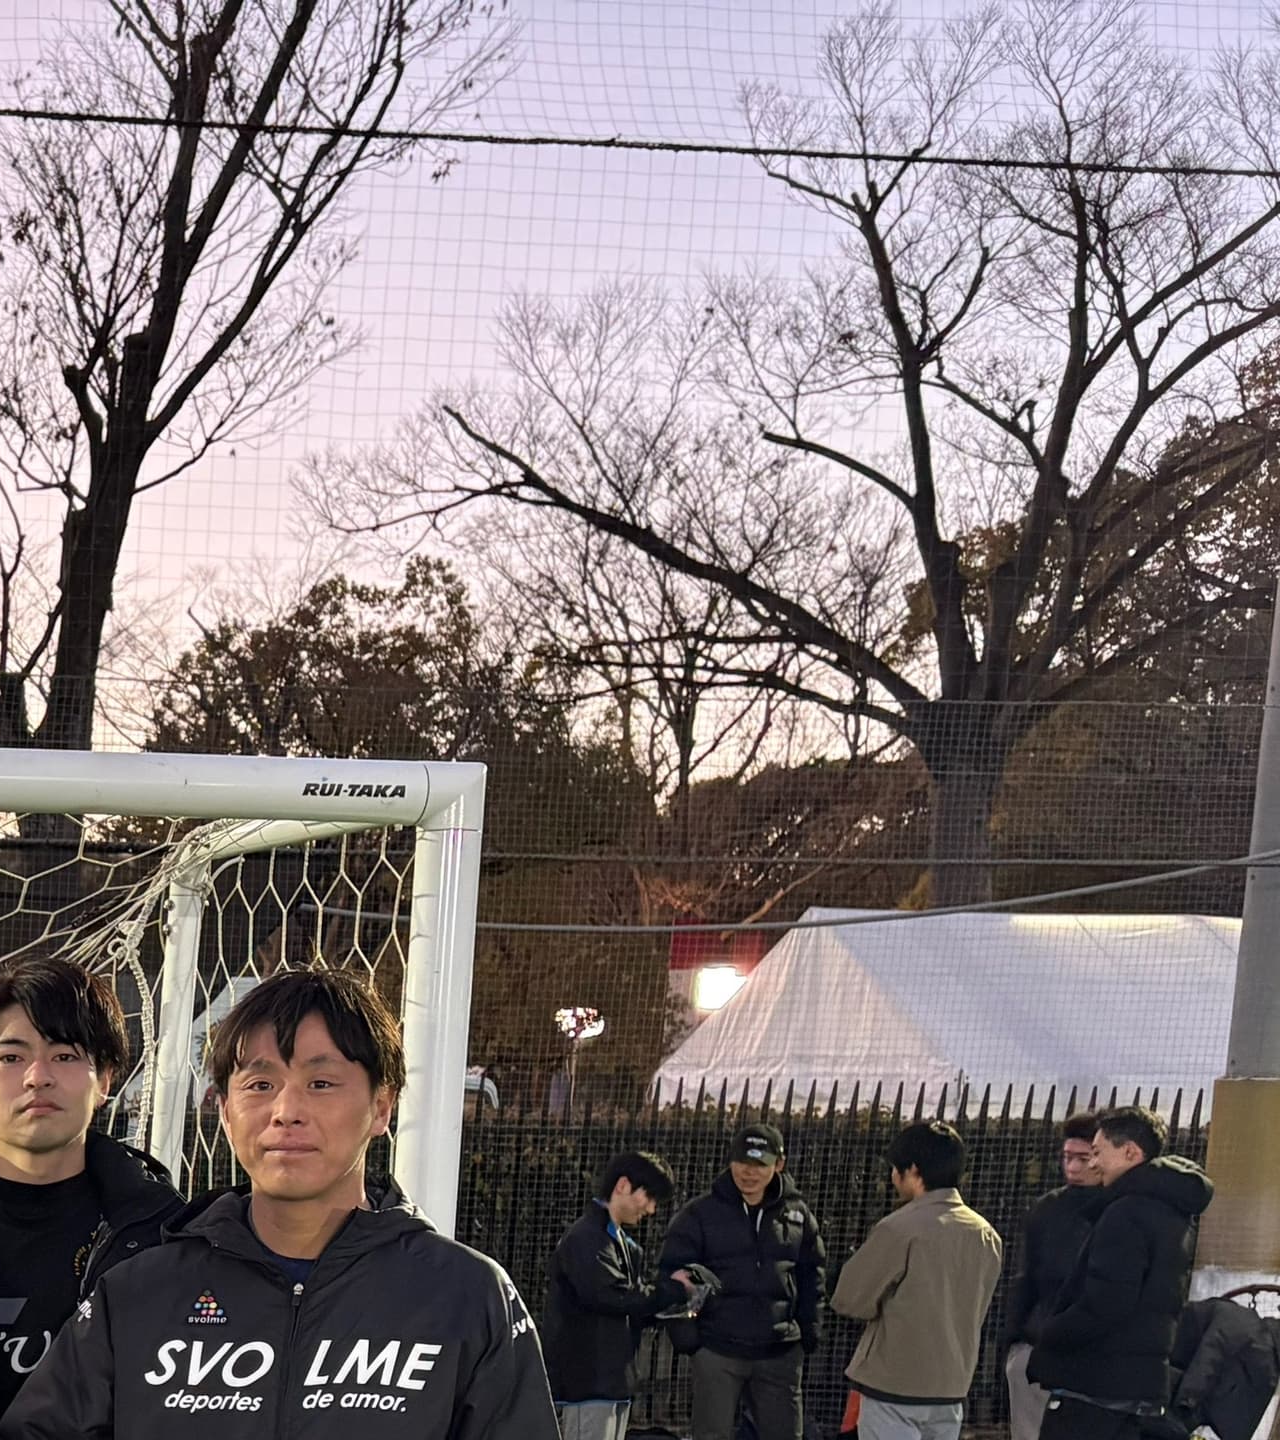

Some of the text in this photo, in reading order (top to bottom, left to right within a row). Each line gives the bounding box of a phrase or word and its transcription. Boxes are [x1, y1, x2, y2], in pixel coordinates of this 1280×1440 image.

[302, 783, 406, 798] RUI-TAKA
[164, 1390, 407, 1413] deportes de amor.
